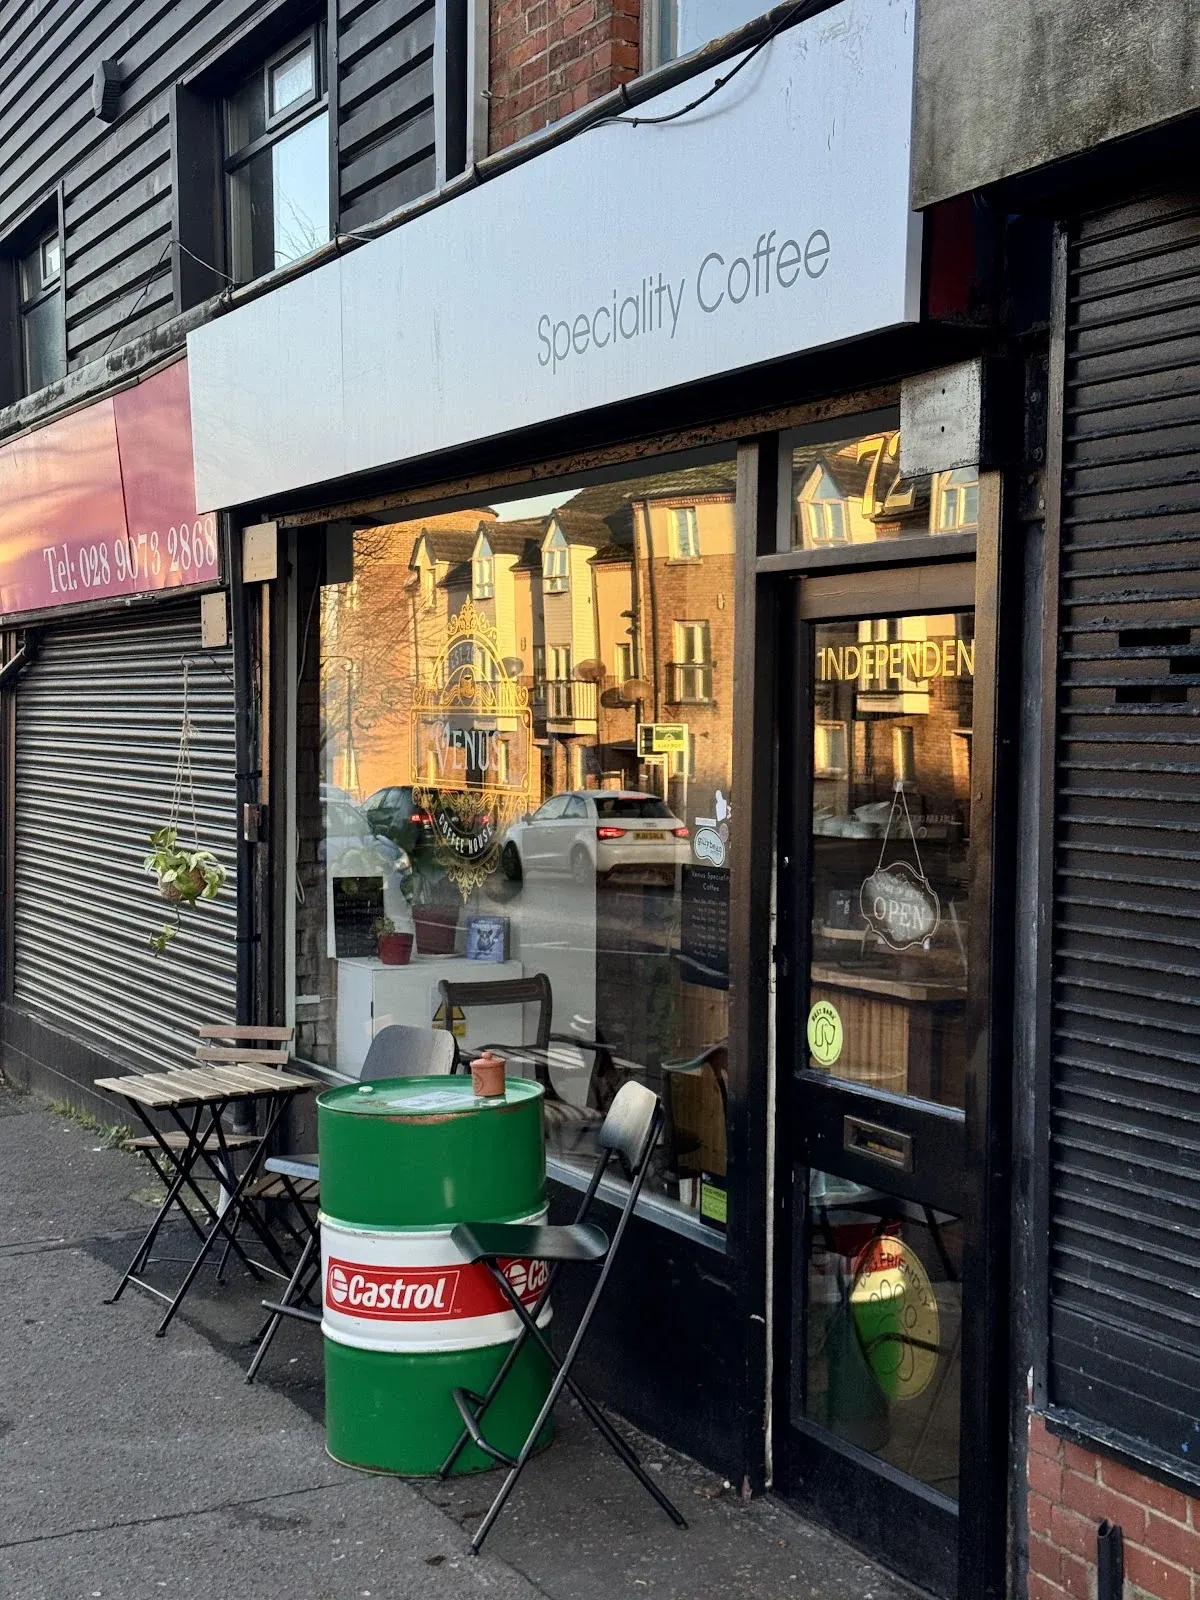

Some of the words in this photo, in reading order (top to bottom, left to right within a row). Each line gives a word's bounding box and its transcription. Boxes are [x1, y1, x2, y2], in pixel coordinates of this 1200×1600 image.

[537, 272, 685, 375] Speciality
[696, 229, 830, 313] Coffee
[43, 545, 76, 594] Tel:
[79, 546, 110, 589] 028
[114, 531, 161, 583] 9073
[168, 516, 216, 573] 2868
[873, 896, 926, 931] OPEN
[348, 1274, 446, 1309] Castrol
